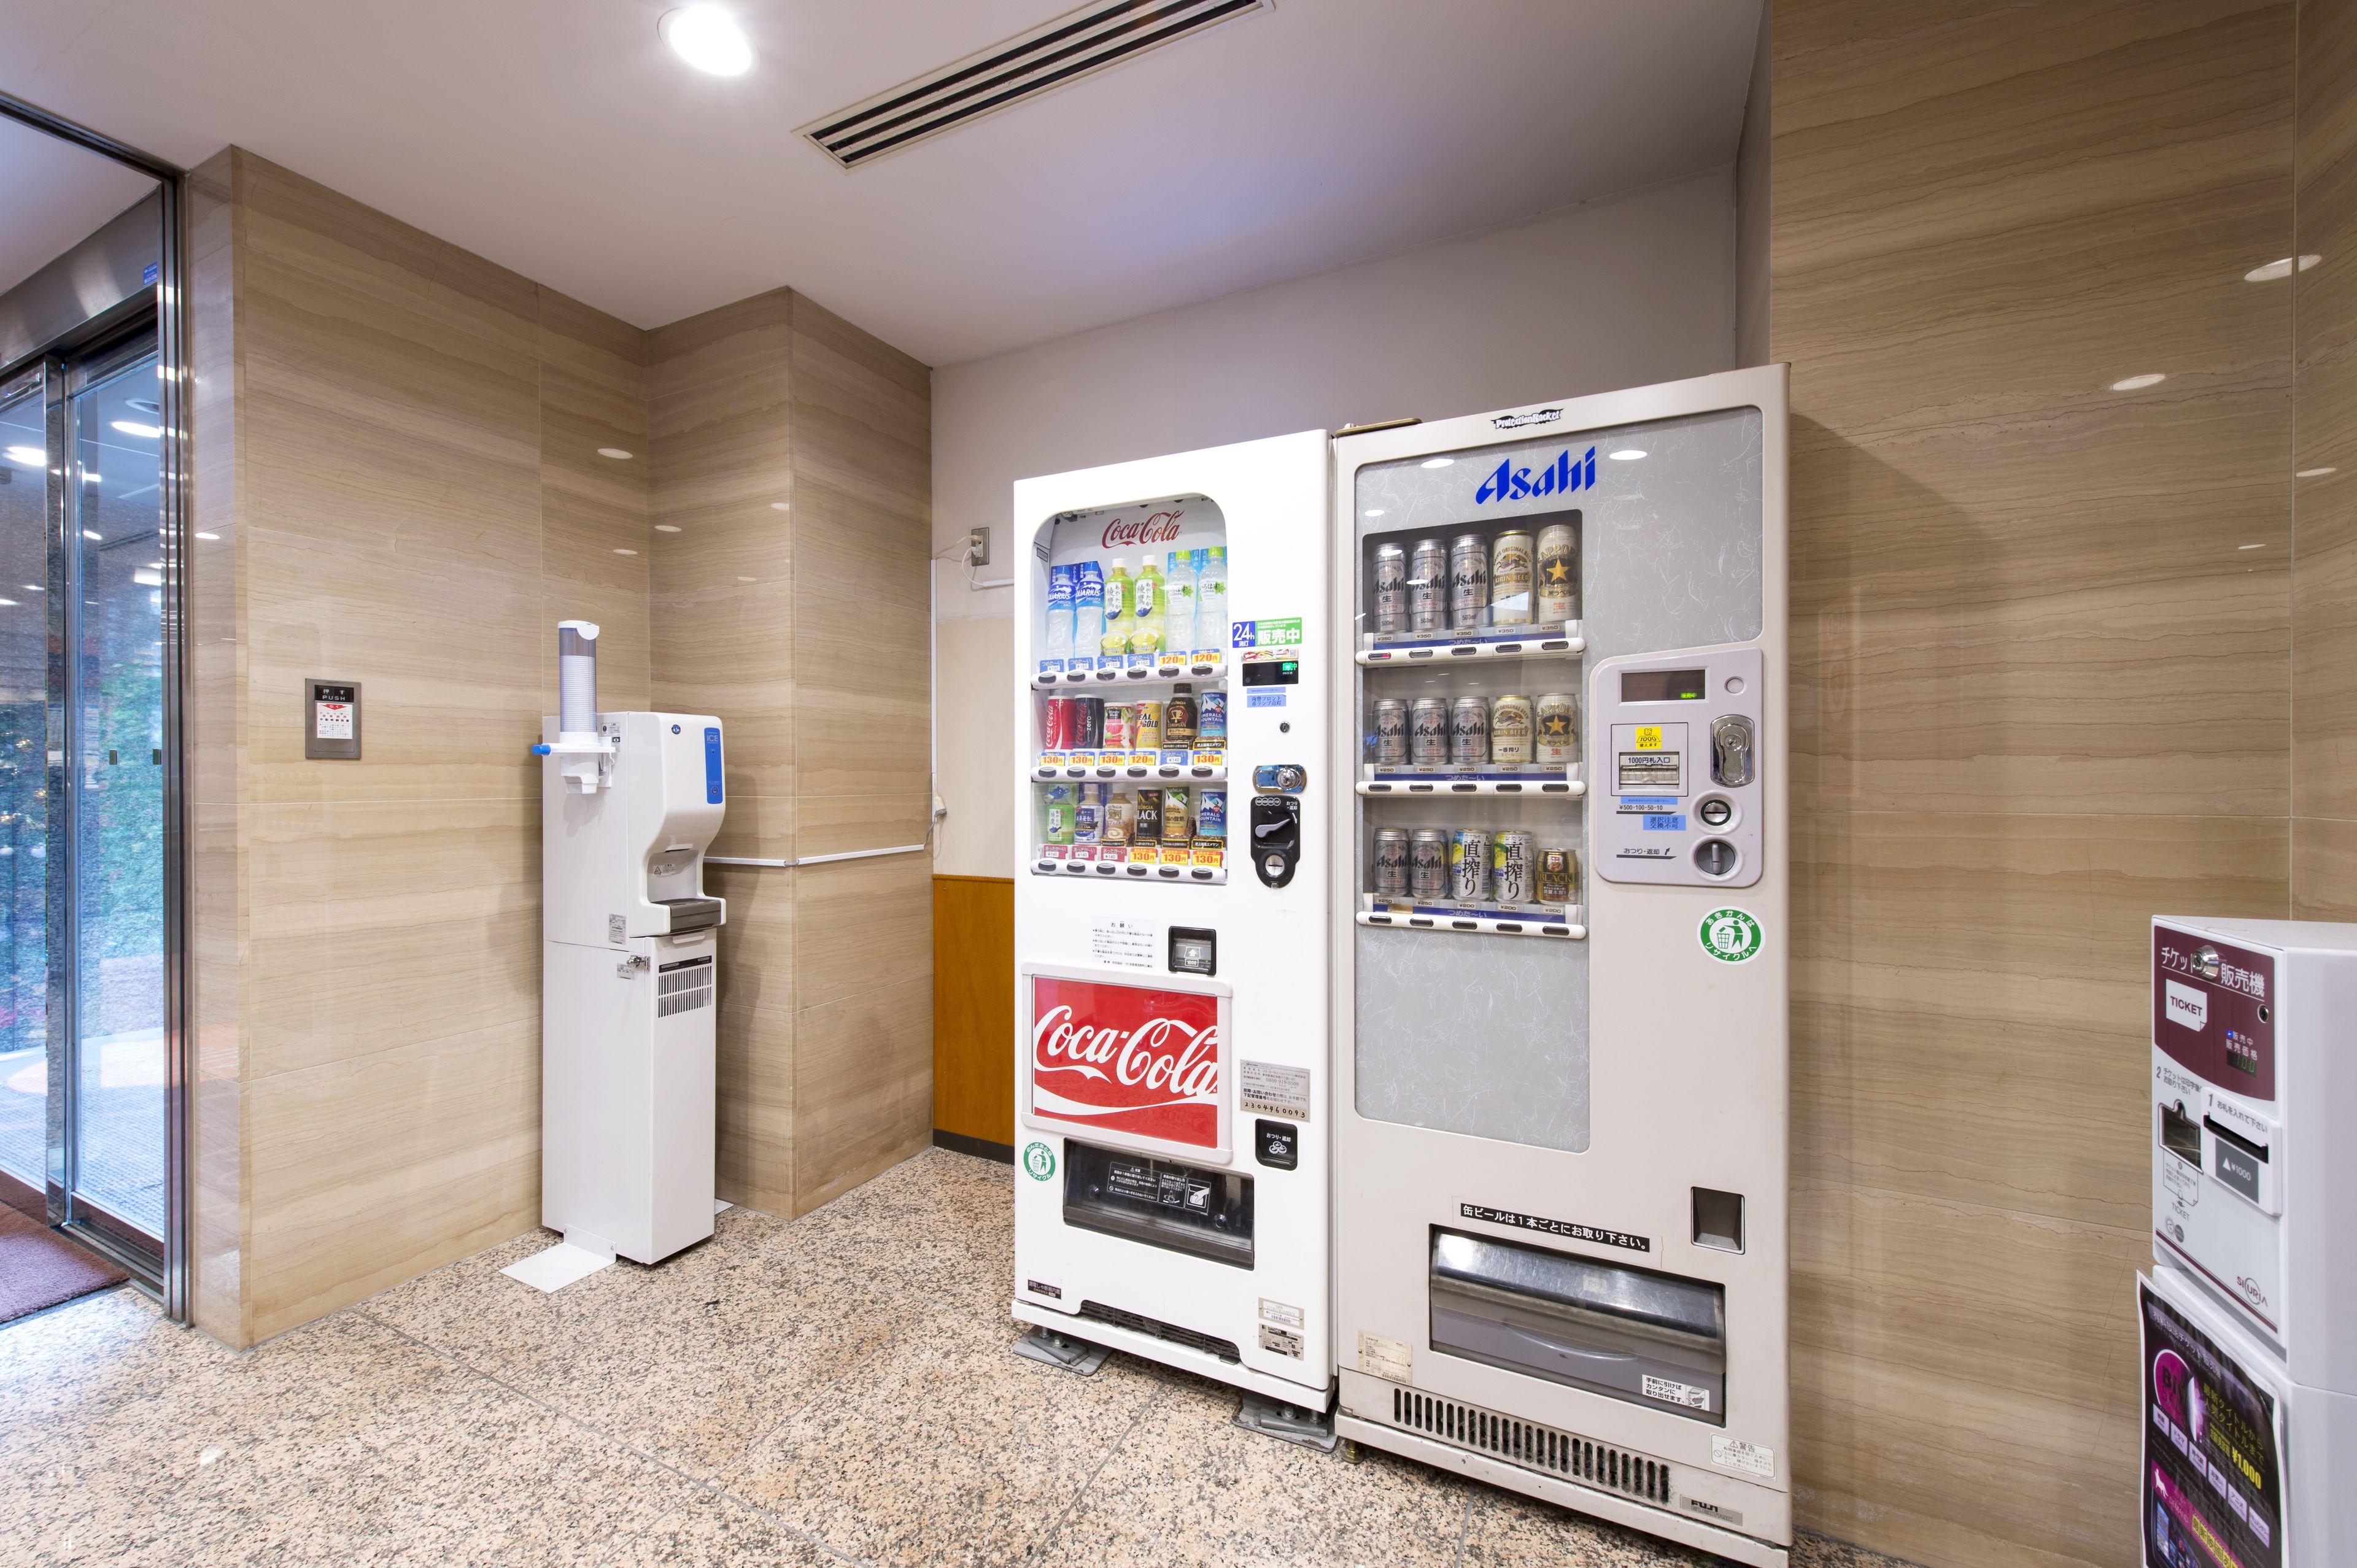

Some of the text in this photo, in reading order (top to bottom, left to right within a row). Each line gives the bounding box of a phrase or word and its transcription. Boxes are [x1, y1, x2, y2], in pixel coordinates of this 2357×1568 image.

[1476, 446, 1595, 504] Asahi
[1102, 510, 1185, 549] Coca-Cola
[1374, 577, 1404, 594] Asahi
[1452, 569, 1486, 589] Asahi
[1495, 575, 1511, 584] KIRIN
[1233, 622, 1255, 641] 24h
[1257, 627, 1300, 645] 販売中
[1045, 705, 1054, 747] Coca-Cola
[1375, 722, 1404, 737] Asahi
[1414, 722, 1446, 736] Asahi
[1453, 722, 1484, 736] Asahi
[1197, 755, 1220, 763] 130円
[1137, 810, 1158, 821] LACK
[1164, 854, 1186, 862] 130円
[1412, 855, 1442, 869] Asahi
[1461, 840, 1480, 896] 直搾り
[1504, 841, 1523, 900] 直搾り
[1539, 873, 1572, 882] BLACK
[1705, 910, 1755, 928] あきかんは
[1705, 942, 1757, 961] リサイクルへ
[2221, 963, 2265, 997] 販売機
[2170, 995, 2202, 1016] TICKET
[2232, 1032, 2253, 1046] 販売中
[1034, 1005, 1217, 1096] Coca-Cola
[2226, 1038, 2258, 1060] 販売価格
[2156, 1066, 2161, 1079] 2
[2236, 1055, 2256, 1073] 100
[1266, 1077, 1299, 1086] 0800-919-0509
[2164, 1075, 2191, 1095] お取り下さい
[2208, 1093, 2268, 1133] 1 お札を入れて下さい
[1266, 1133, 1291, 1142] おつり・返却
[1026, 1142, 1053, 1157] のんだあとは
[1028, 1168, 1051, 1181] リサイクル
[2231, 1162, 2251, 1181] ¥1000
[2172, 1202, 2190, 1221] TICKET
[1463, 1204, 1646, 1250] 缶ビールは1本ごとにお取り下さい。
[1646, 1377, 1682, 1390] 手前に引けば
[1646, 1383, 1676, 1395] カンタンに
[1646, 1389, 1685, 1404] 取り出せます。
[2203, 1382, 2264, 1450] 最新タイトルから
[2205, 1397, 2264, 1466] 人気タイトルまで
[1740, 1442, 1755, 1452] 警告
[2232, 1446, 2262, 1490] ¥1,000
[1691, 1499, 1718, 1513] FUJI
